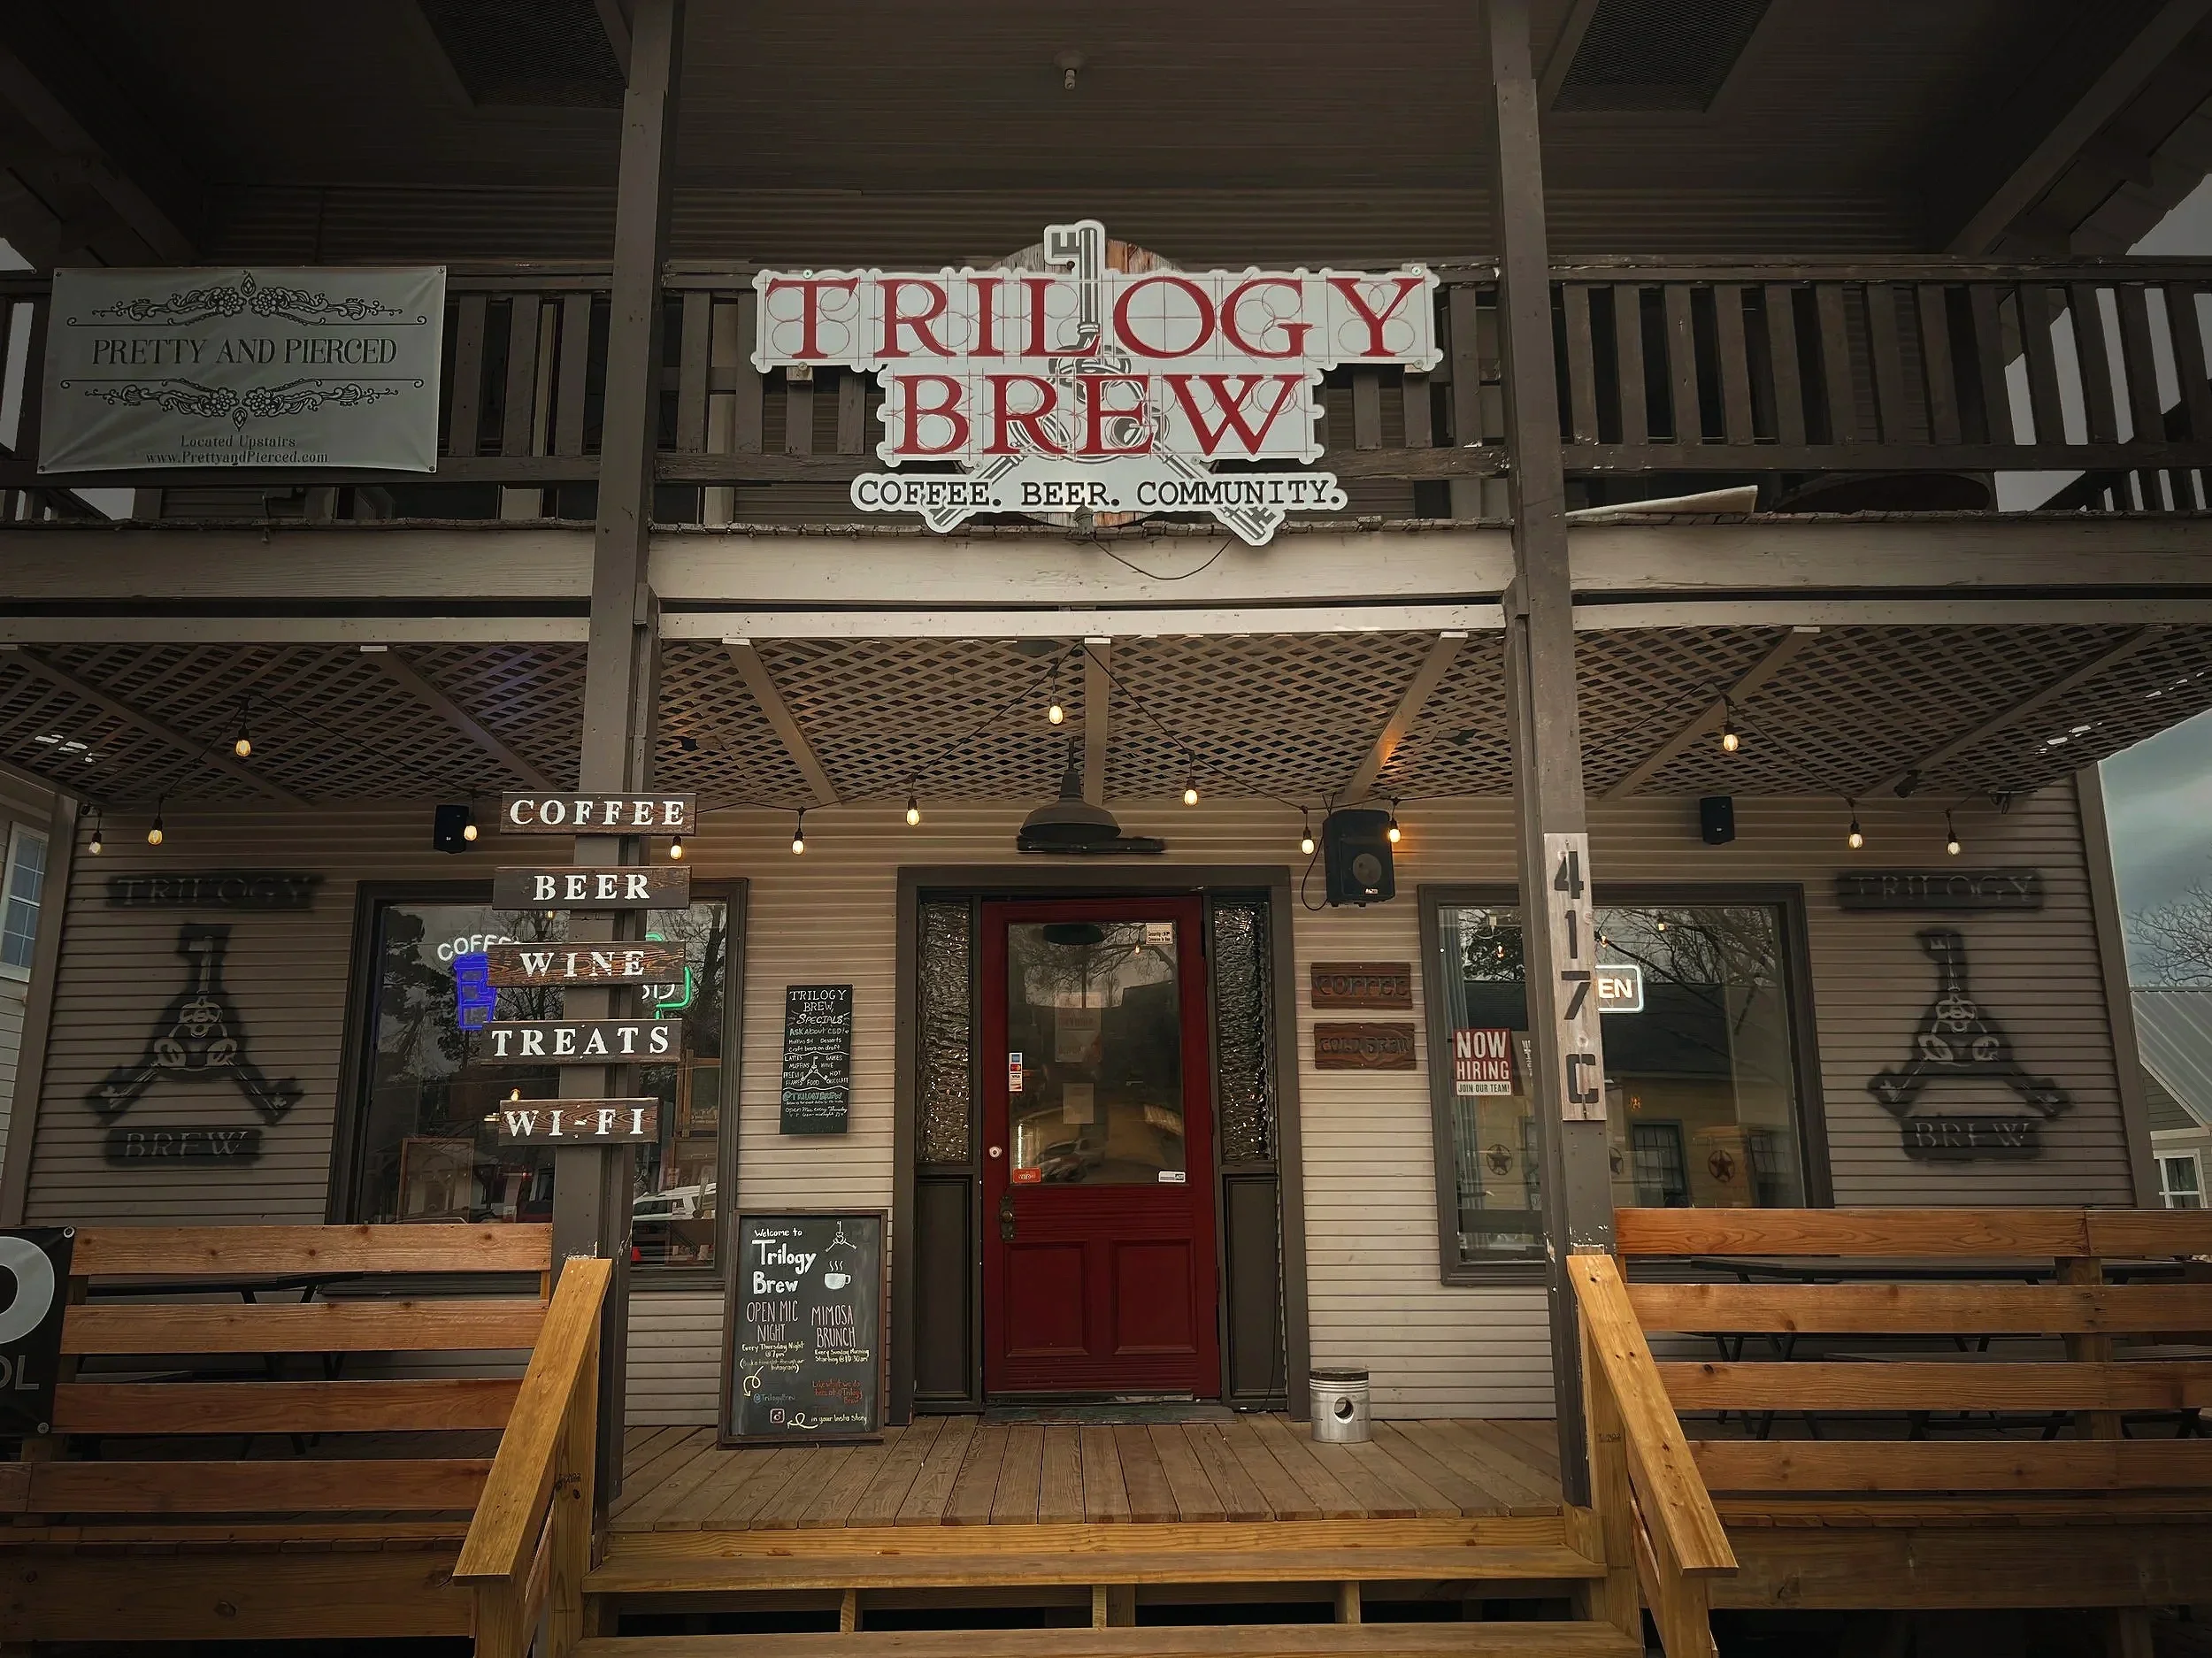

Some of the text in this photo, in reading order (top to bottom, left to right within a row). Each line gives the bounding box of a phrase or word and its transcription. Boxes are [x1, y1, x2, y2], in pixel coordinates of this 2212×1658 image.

[765, 276, 1424, 358] TRILOGY
[92, 337, 398, 365] PRETTY AND PIERCED
[893, 373, 1305, 456] BREW
[180, 434, 296, 450] Located Upstairs
[145, 449, 329, 465] www.PrettyandPierced.com
[857, 480, 1341, 508] COFFEE. BEER. COMMUNITY.
[510, 799, 685, 825] COFFEE
[533, 873, 651, 902] BEER
[519, 949, 646, 978] WINE
[789, 989, 847, 1001] TRILOGY
[1315, 974, 1412, 998] COFFEE
[1598, 978, 1633, 999] EN
[490, 1025, 670, 1057] TREATS
[1319, 1037, 1361, 1054] COLD
[1456, 1031, 1507, 1059] NOW
[1455, 1060, 1509, 1080] HIRING
[1458, 1084, 1509, 1093] JOIN OUR TEAM!
[503, 1107, 646, 1137] WI-FI
[793, 1227, 803, 1237] to
[752, 1239, 817, 1275] Trilogy
[753, 1270, 799, 1294] Brew
[746, 1300, 799, 1323] OPEN MIC
[811, 1304, 854, 1326] MIMOSA
[757, 1324, 786, 1342] NIGHT
[817, 1326, 856, 1348] BRUNCH
[741, 1343, 759, 1353] Every
